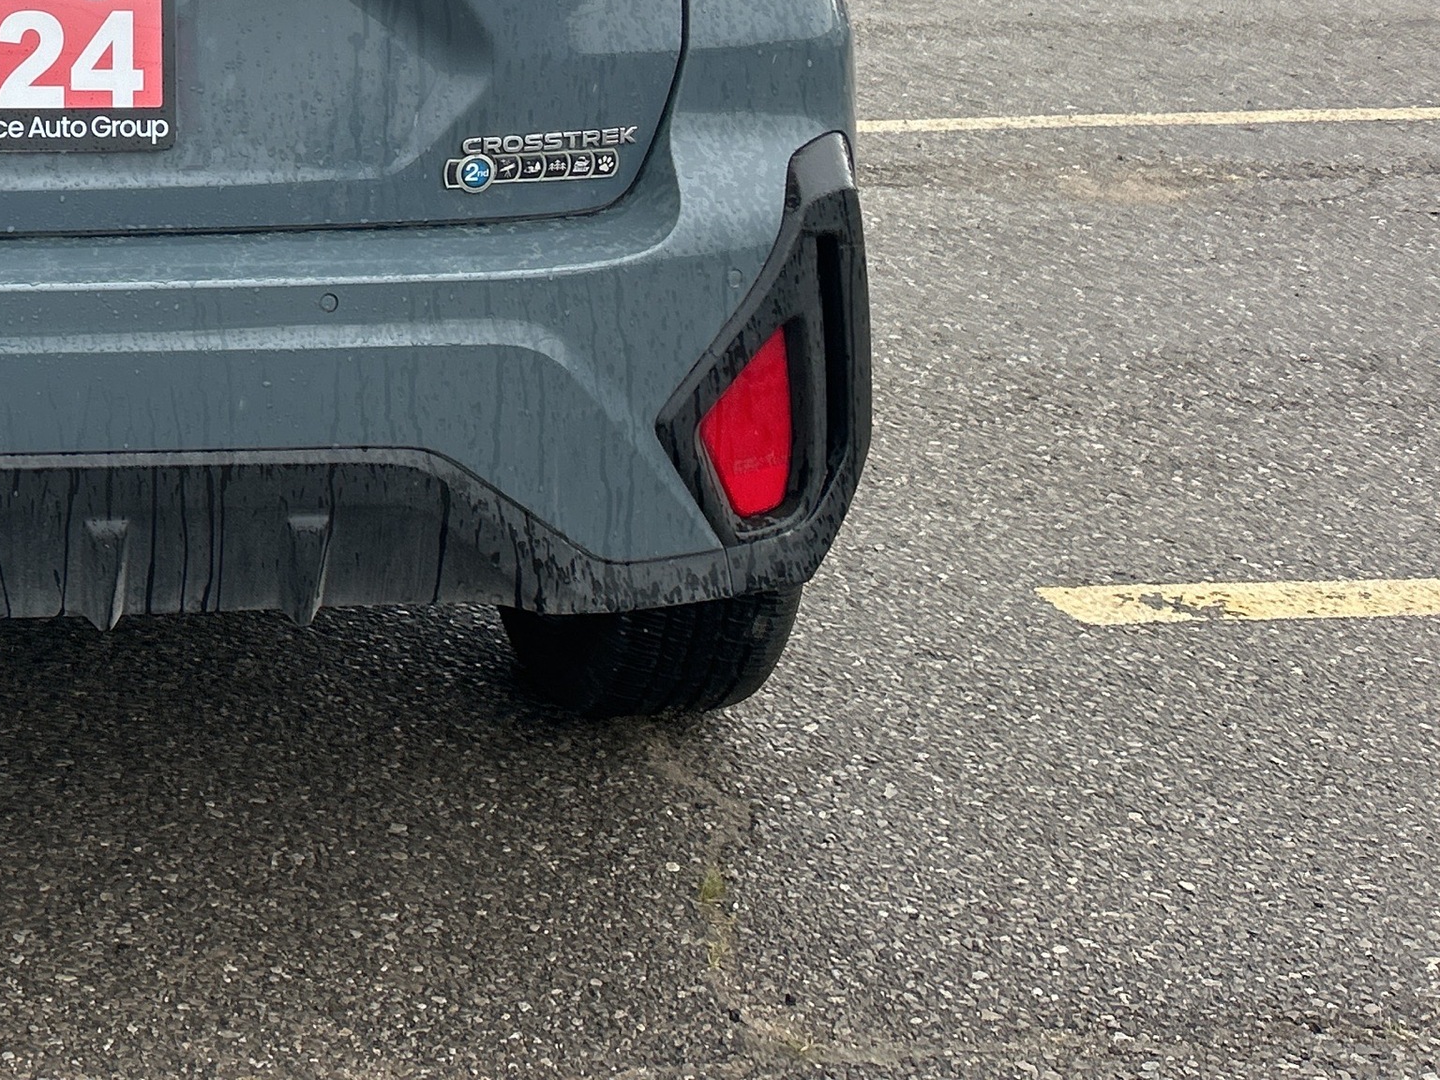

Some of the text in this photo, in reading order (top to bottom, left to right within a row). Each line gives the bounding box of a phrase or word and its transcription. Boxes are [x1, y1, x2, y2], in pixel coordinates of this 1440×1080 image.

[29, 116, 87, 139] Auto
[91, 116, 169, 145] Group
[462, 125, 638, 155] CROSSTREK
[464, 162, 490, 182] 2nd
